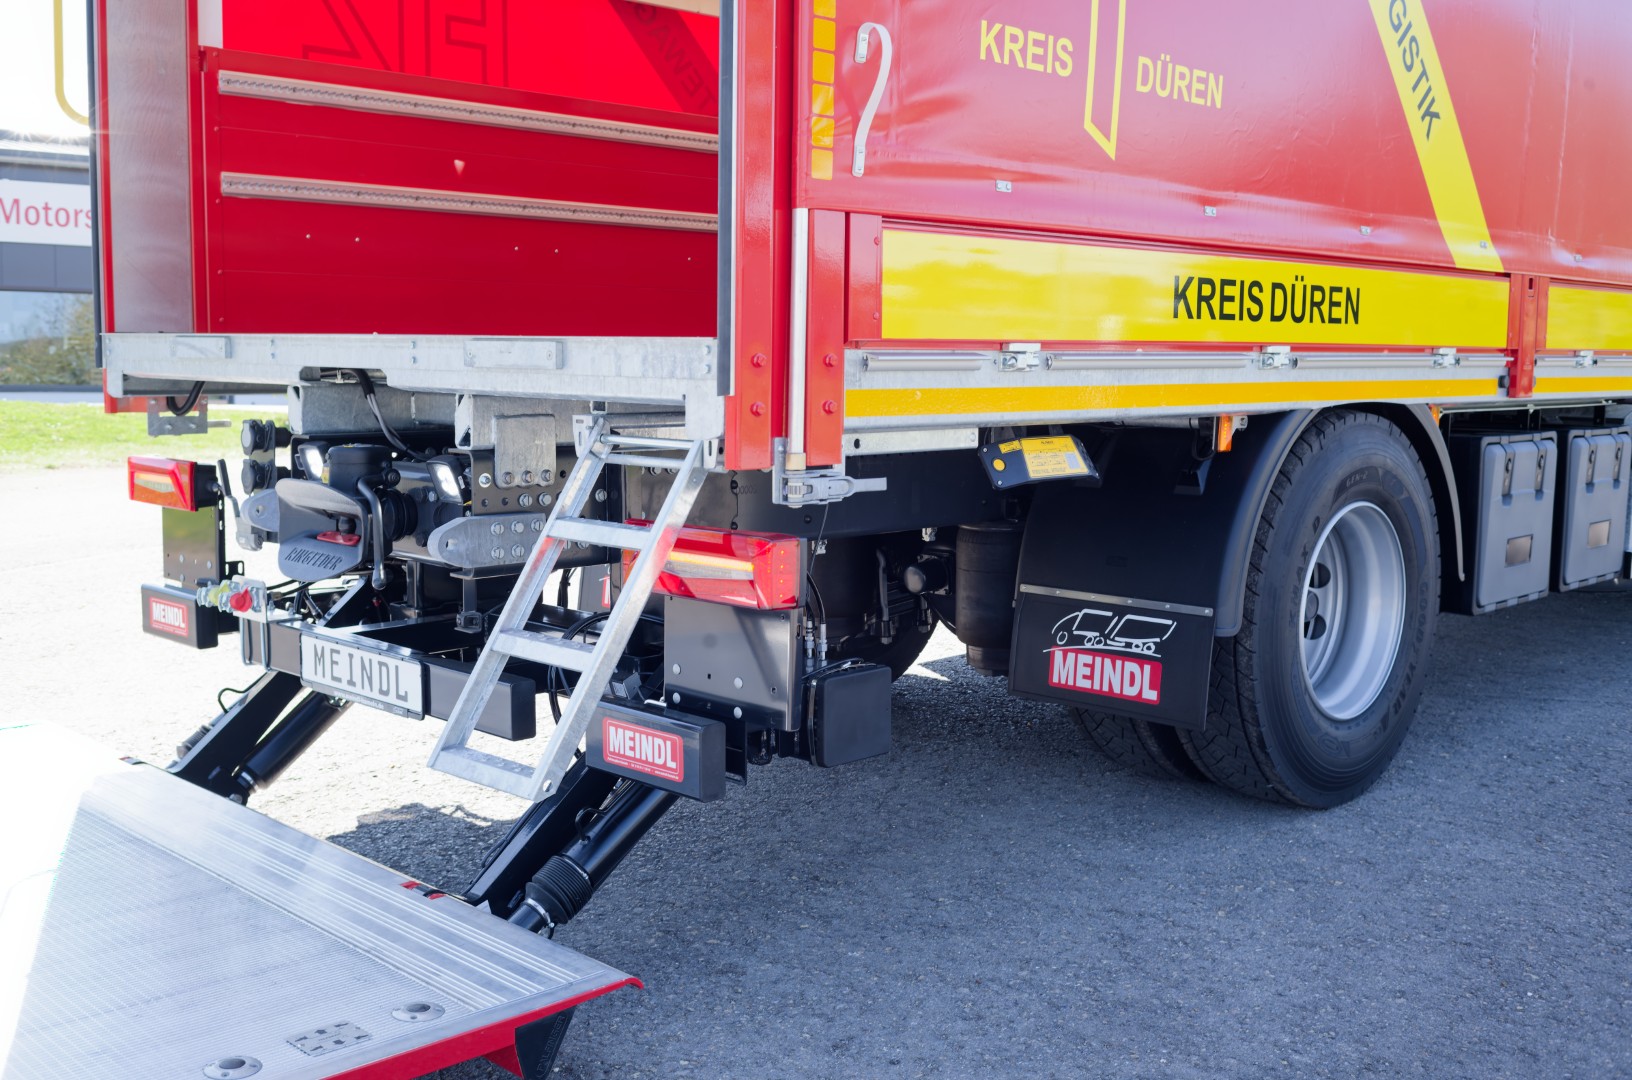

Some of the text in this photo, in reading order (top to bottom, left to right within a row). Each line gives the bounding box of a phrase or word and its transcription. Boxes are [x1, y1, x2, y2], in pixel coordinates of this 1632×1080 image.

[980, 19, 1224, 109] KREIS DÜREN
[1389, 0, 1441, 141] GISTIK
[1173, 275, 1361, 324] KREIS DÜREN
[152, 601, 186, 629] MEINDL
[313, 643, 408, 703] MEINDL
[1052, 650, 1158, 701] MEINDL
[608, 725, 677, 769] MEINDL
